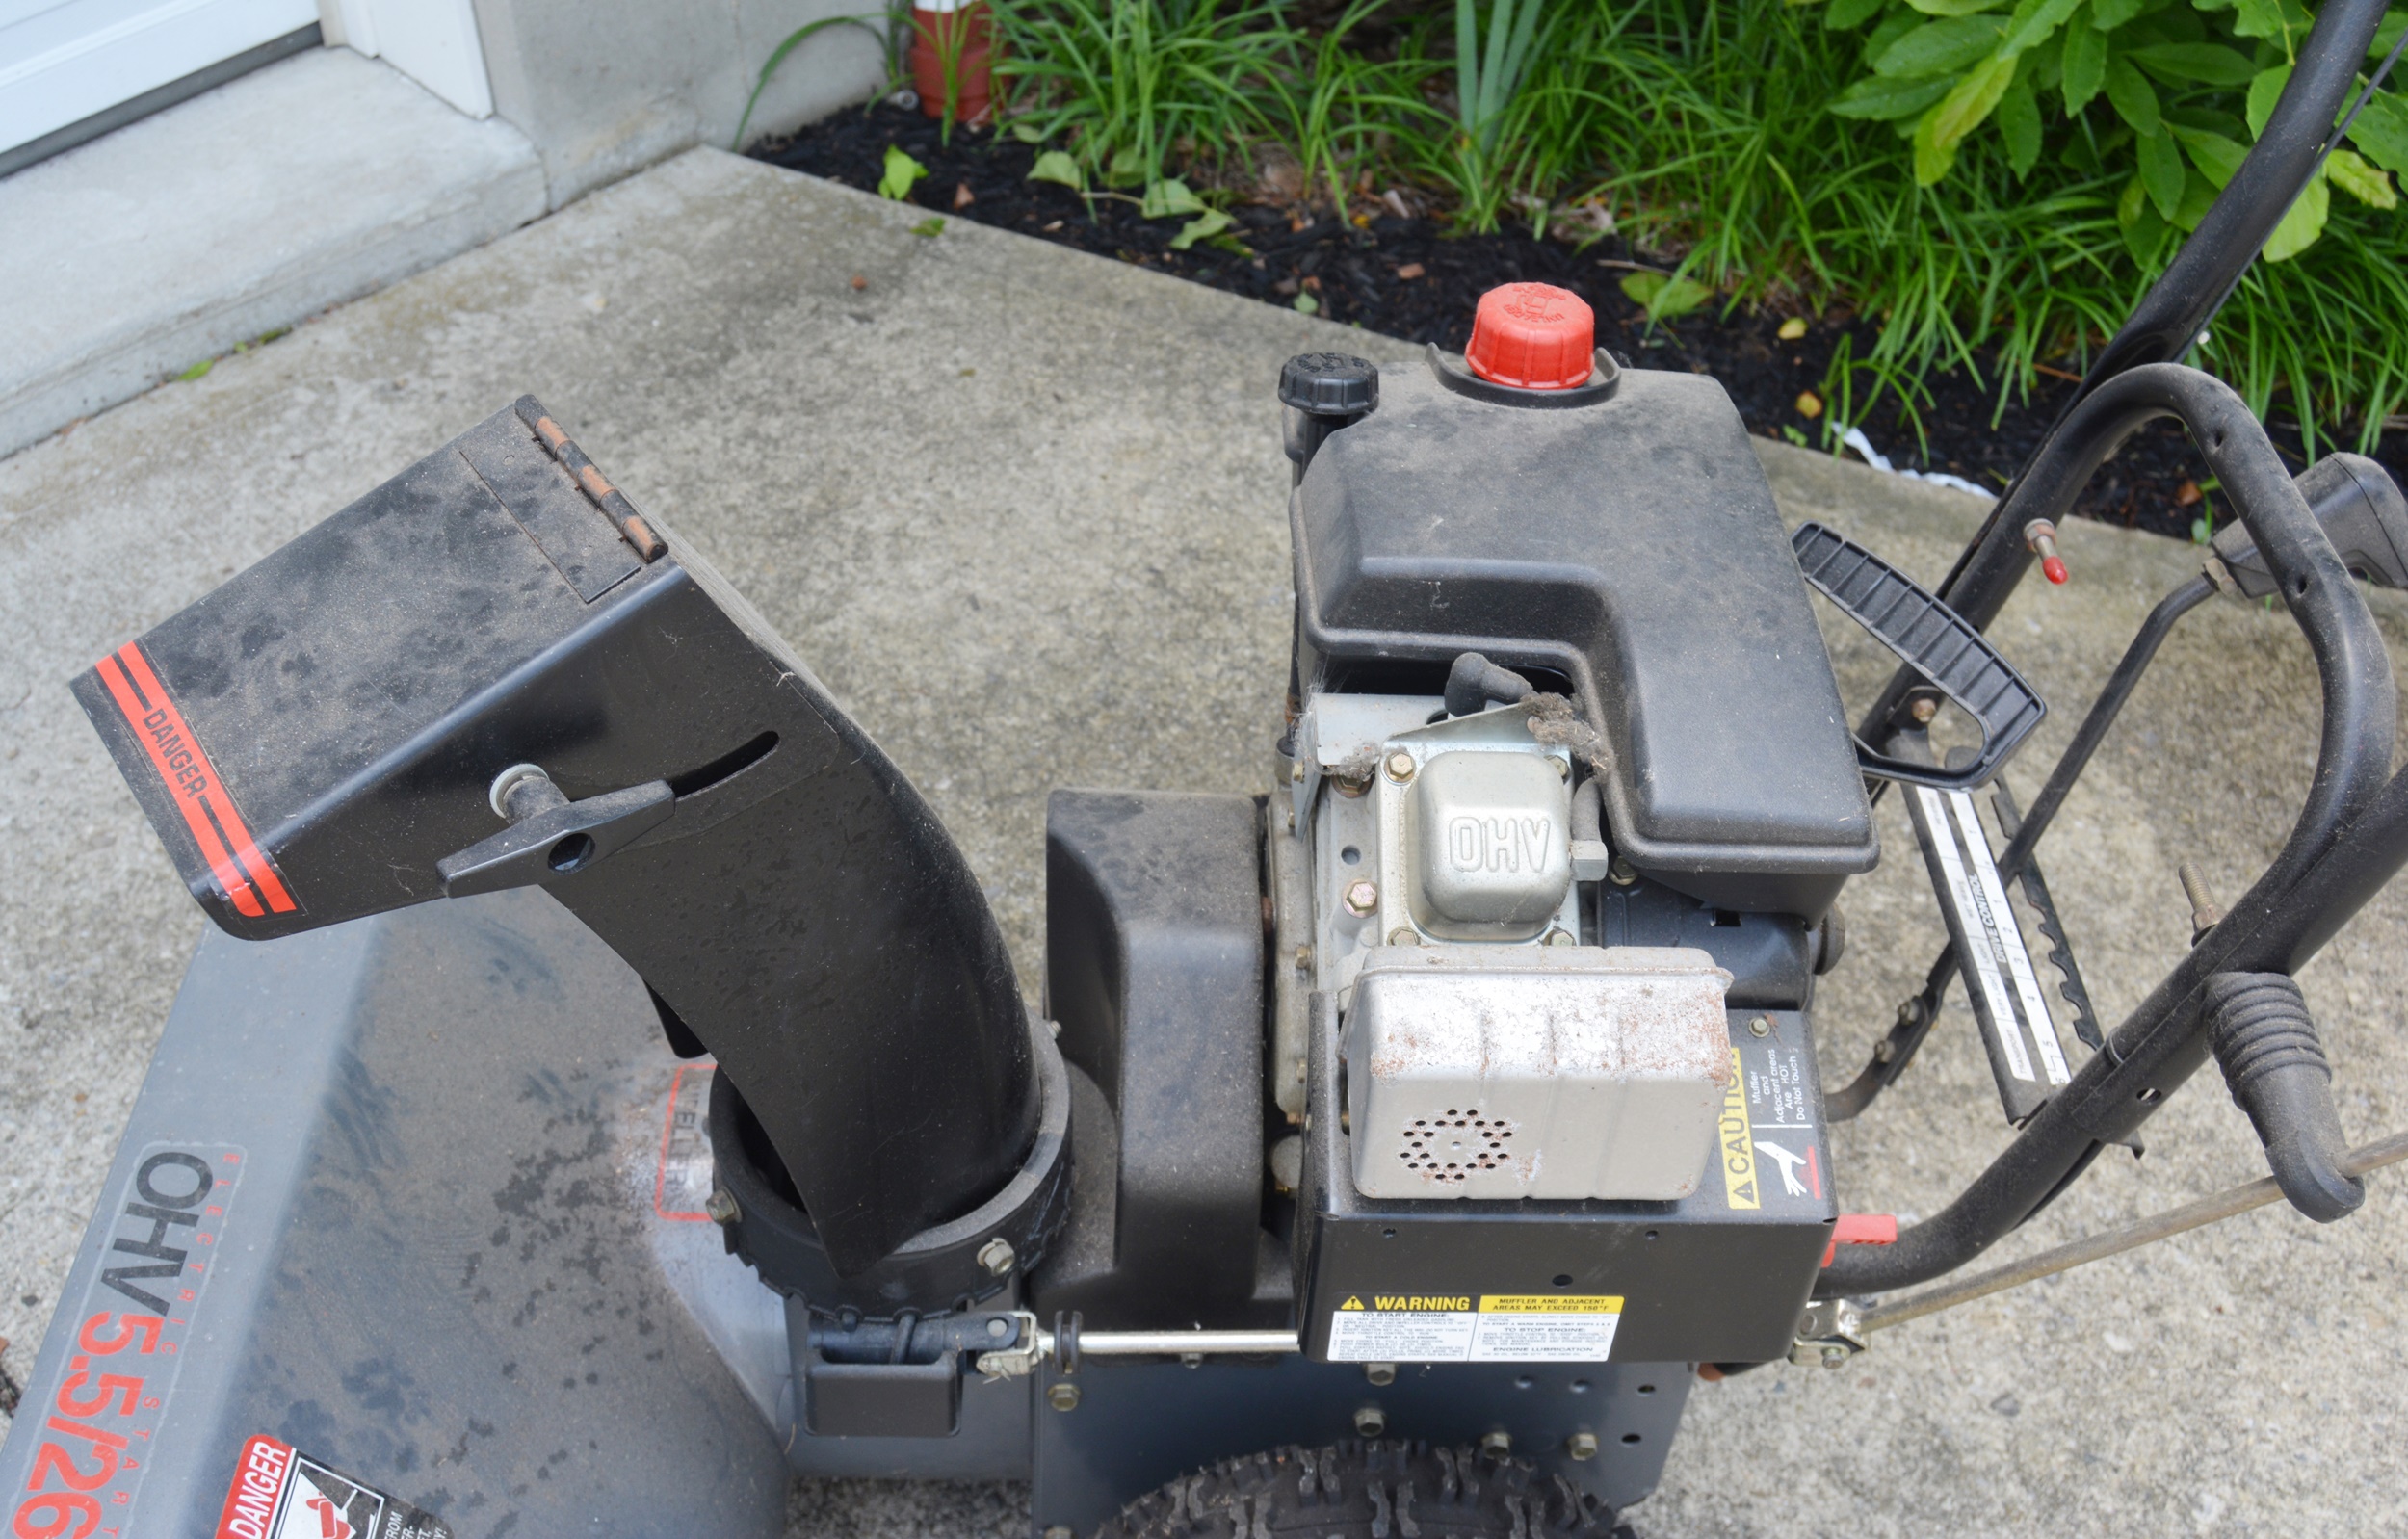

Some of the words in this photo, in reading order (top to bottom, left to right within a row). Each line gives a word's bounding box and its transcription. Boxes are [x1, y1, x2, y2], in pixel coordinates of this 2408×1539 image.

[144, 708, 207, 799] DANGER
[1449, 817, 1551, 873] OHV
[1969, 873, 1995, 926] CONTROL
[1984, 926, 2007, 963] DRIVE
[1767, 1049, 1778, 1077] areas
[1779, 1064, 1790, 1084] HOT
[1789, 1056, 1800, 1085] Touch
[1750, 1071, 1762, 1104] Muffler
[1760, 1075, 1770, 1095] and
[1771, 1078, 1785, 1124] Adjacent
[1784, 1091, 1793, 1109] Are
[1793, 1086, 1803, 1105] Not
[1796, 1106, 1806, 1121] Do
[100, 1151, 214, 1316] OHV
[161, 1152, 241, 1355] ELECTRIC
[1374, 1296, 1471, 1311] WARNING
[13, 1311, 165, 1539] 5.5/26
[102, 1396, 161, 1539] START
[228, 1441, 287, 1539] DANGER
